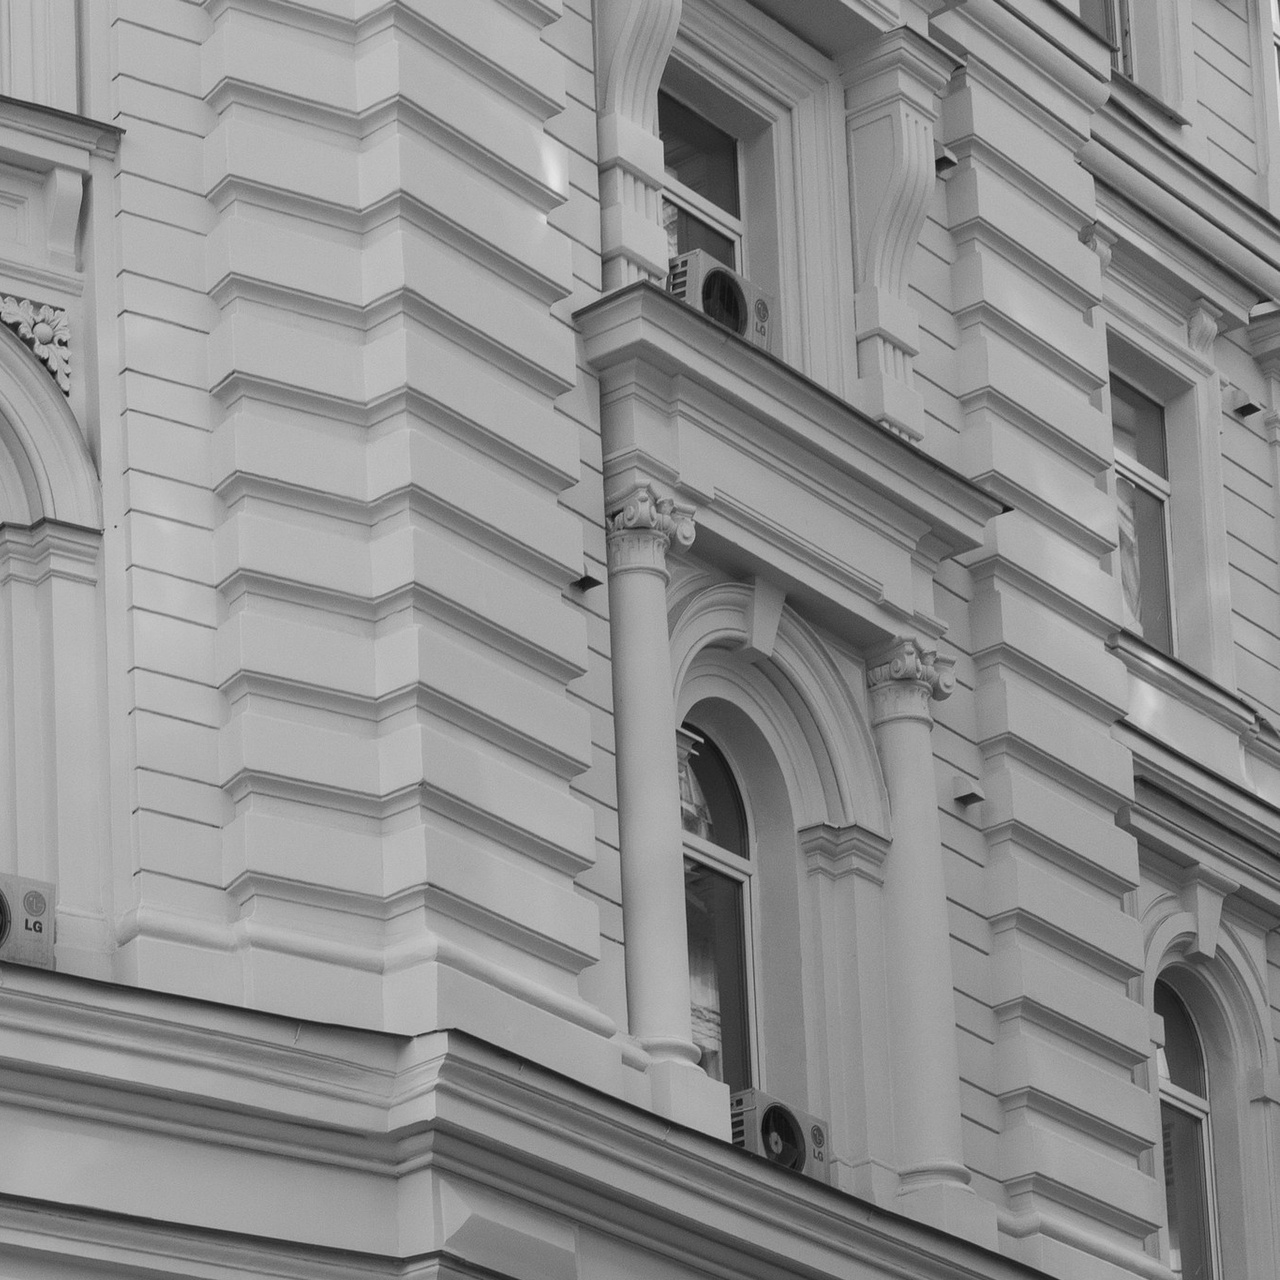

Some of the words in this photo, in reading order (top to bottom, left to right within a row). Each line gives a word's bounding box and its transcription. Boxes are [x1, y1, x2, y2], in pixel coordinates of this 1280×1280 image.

[755, 321, 766, 337] LG
[24, 918, 43, 933] LG
[812, 1148, 824, 1162] LG
